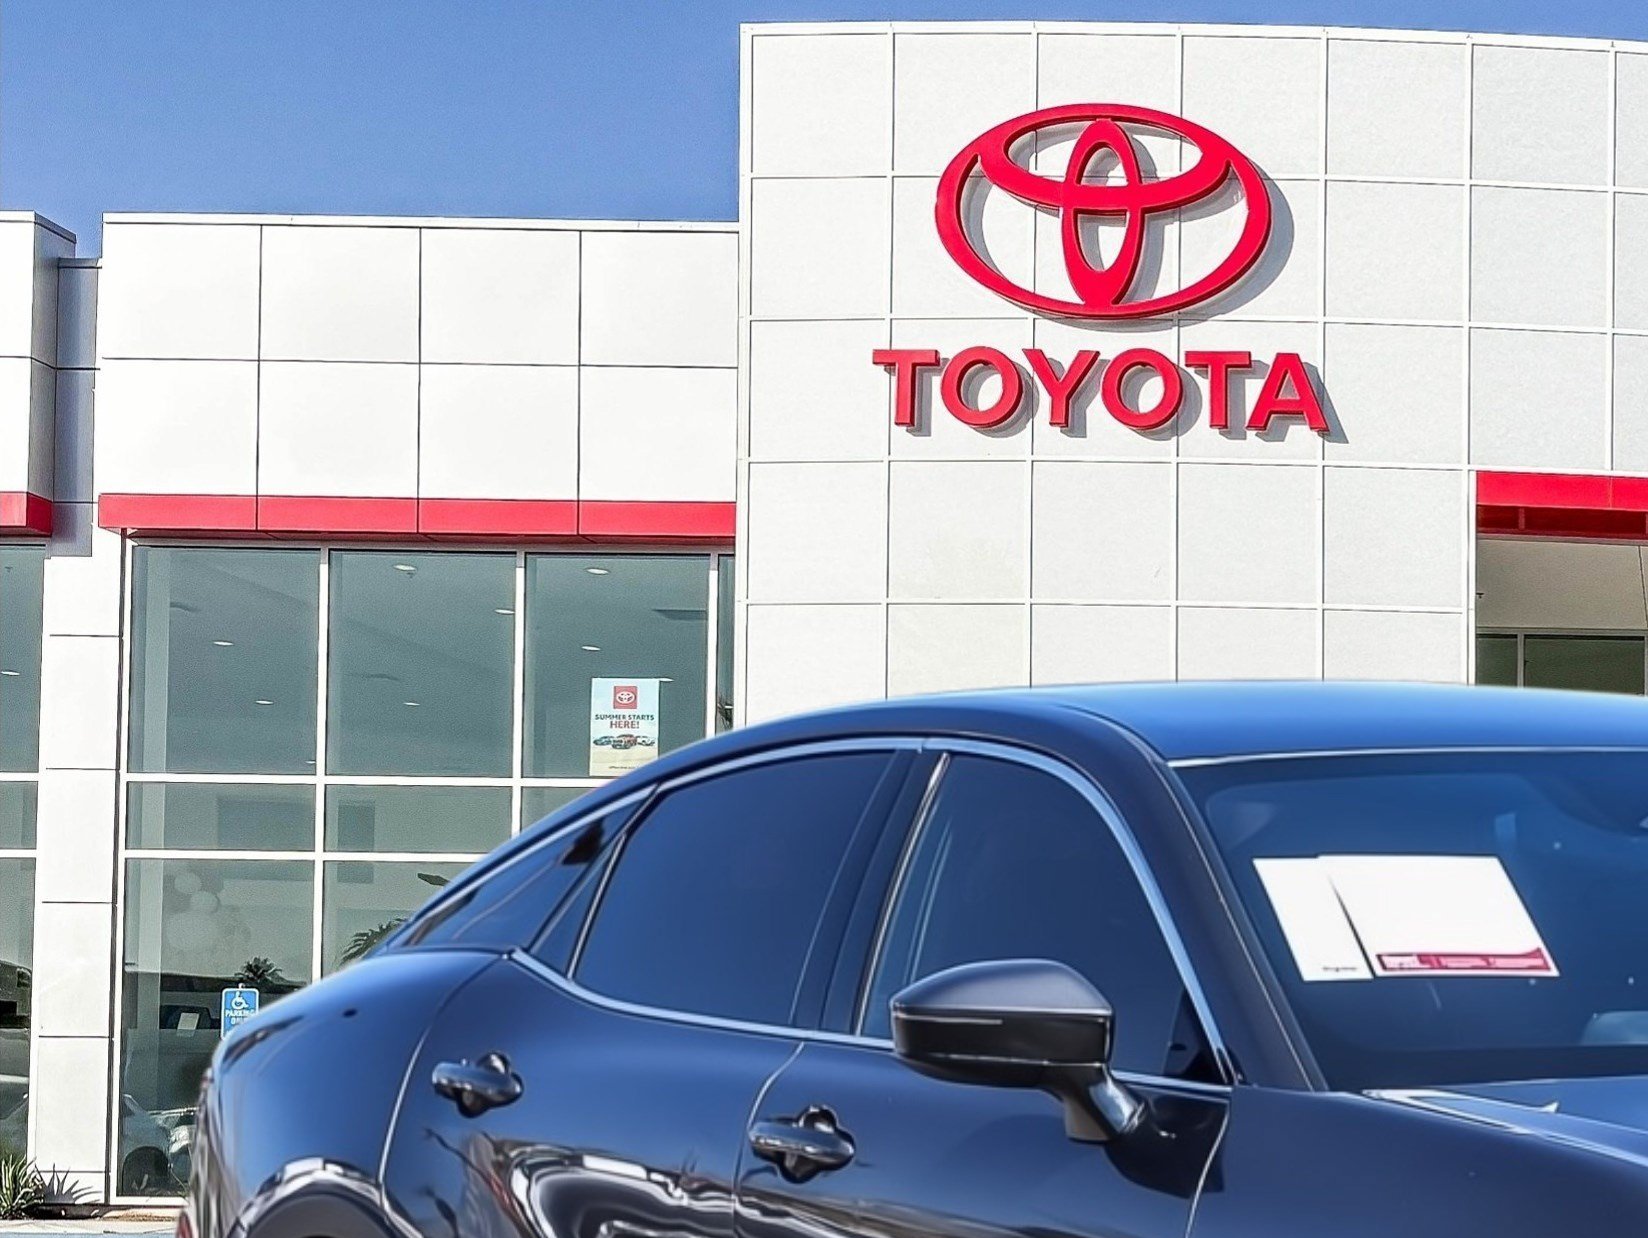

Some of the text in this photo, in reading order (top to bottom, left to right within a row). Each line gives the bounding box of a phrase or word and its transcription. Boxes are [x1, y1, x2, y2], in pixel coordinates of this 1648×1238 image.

[872, 345, 1329, 432] TOYOTA
[594, 713, 655, 721] SUMMER STARTS
[609, 720, 640, 729] HERE!
